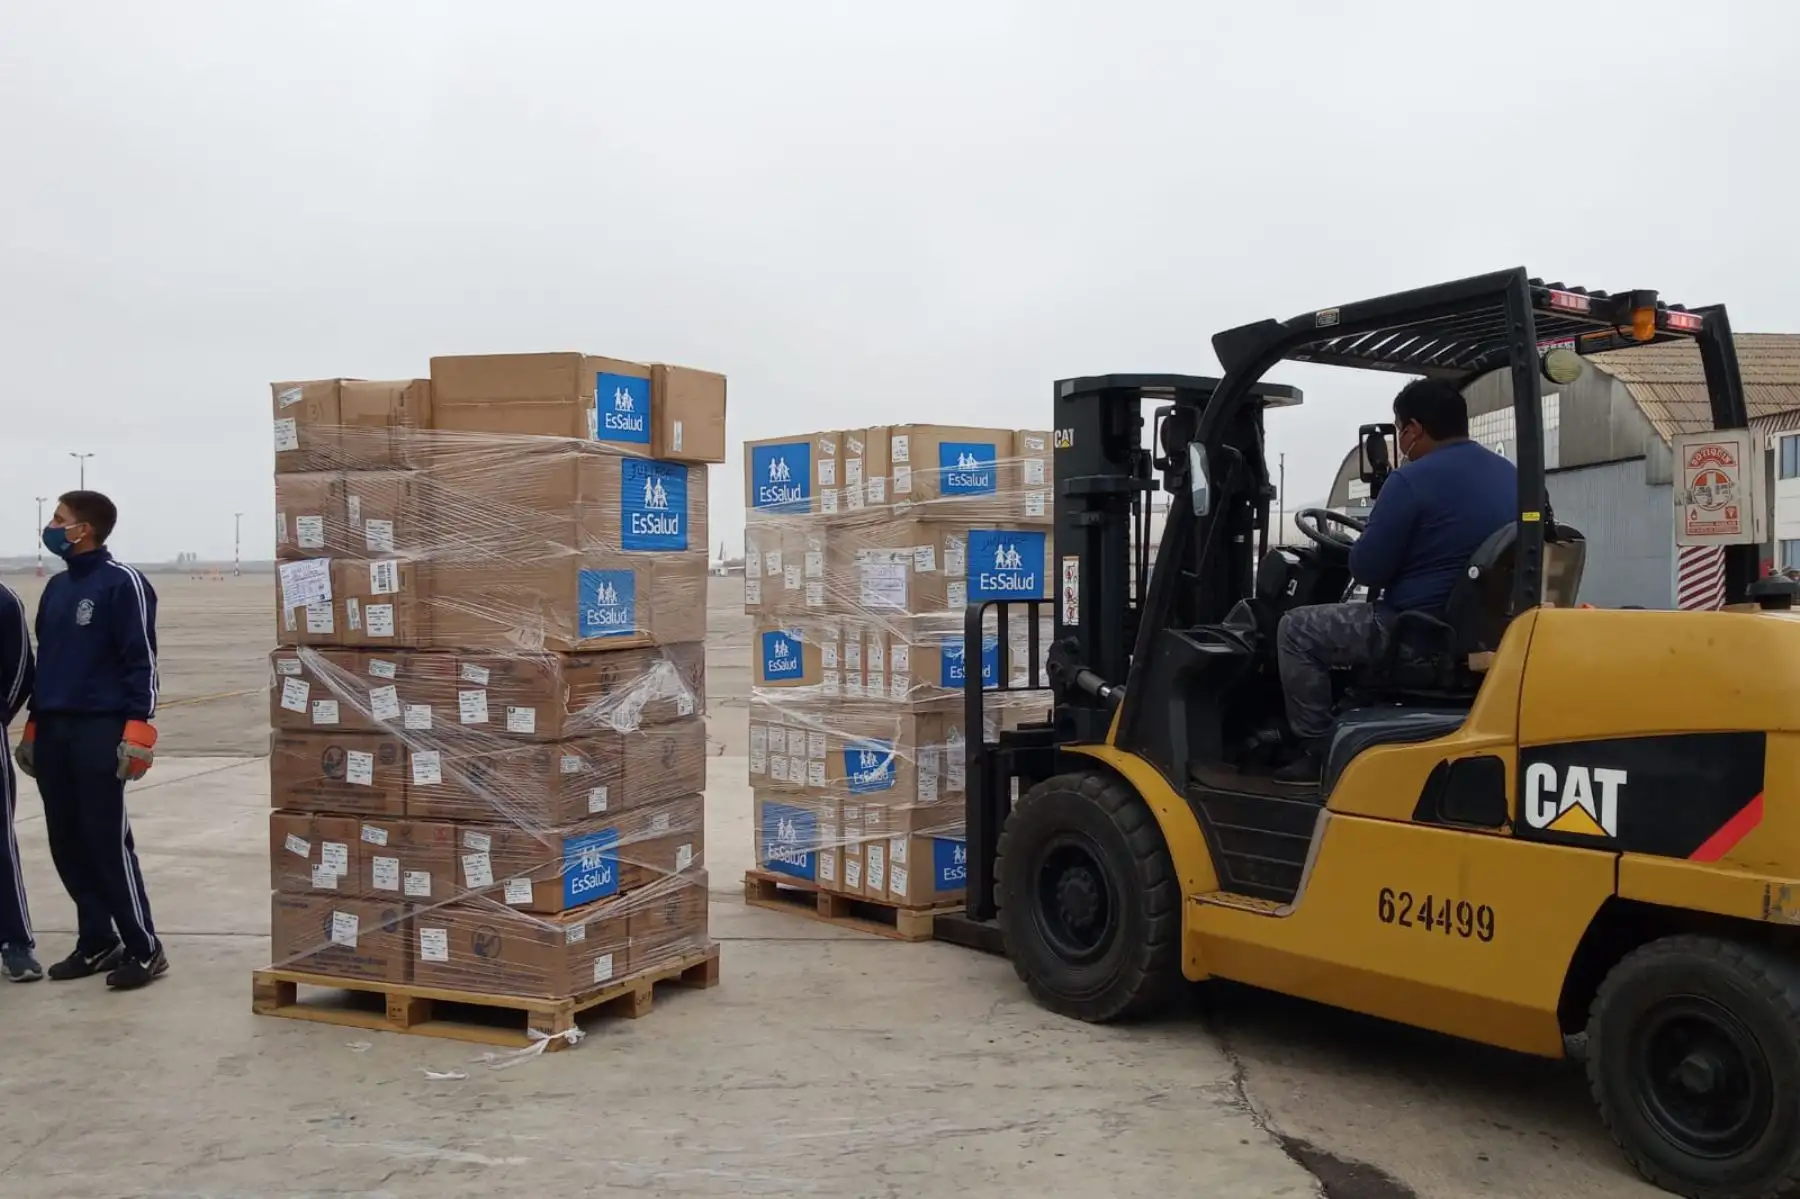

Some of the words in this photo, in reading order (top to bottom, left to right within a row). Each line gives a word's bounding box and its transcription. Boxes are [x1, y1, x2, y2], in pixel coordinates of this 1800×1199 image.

[605, 412, 643, 432] EsSalud
[1054, 428, 1075, 449] CAT
[947, 471, 989, 487] EsSalud
[759, 482, 801, 503] EsSalud
[631, 512, 679, 535] EsSalud
[980, 572, 1035, 590] EsSalud
[587, 607, 628, 625] EsSalud
[768, 656, 797, 672] EsSalud
[1525, 762, 1628, 838] CAT
[572, 866, 611, 894] EsSalud
[1378, 887, 1495, 943] 624499
